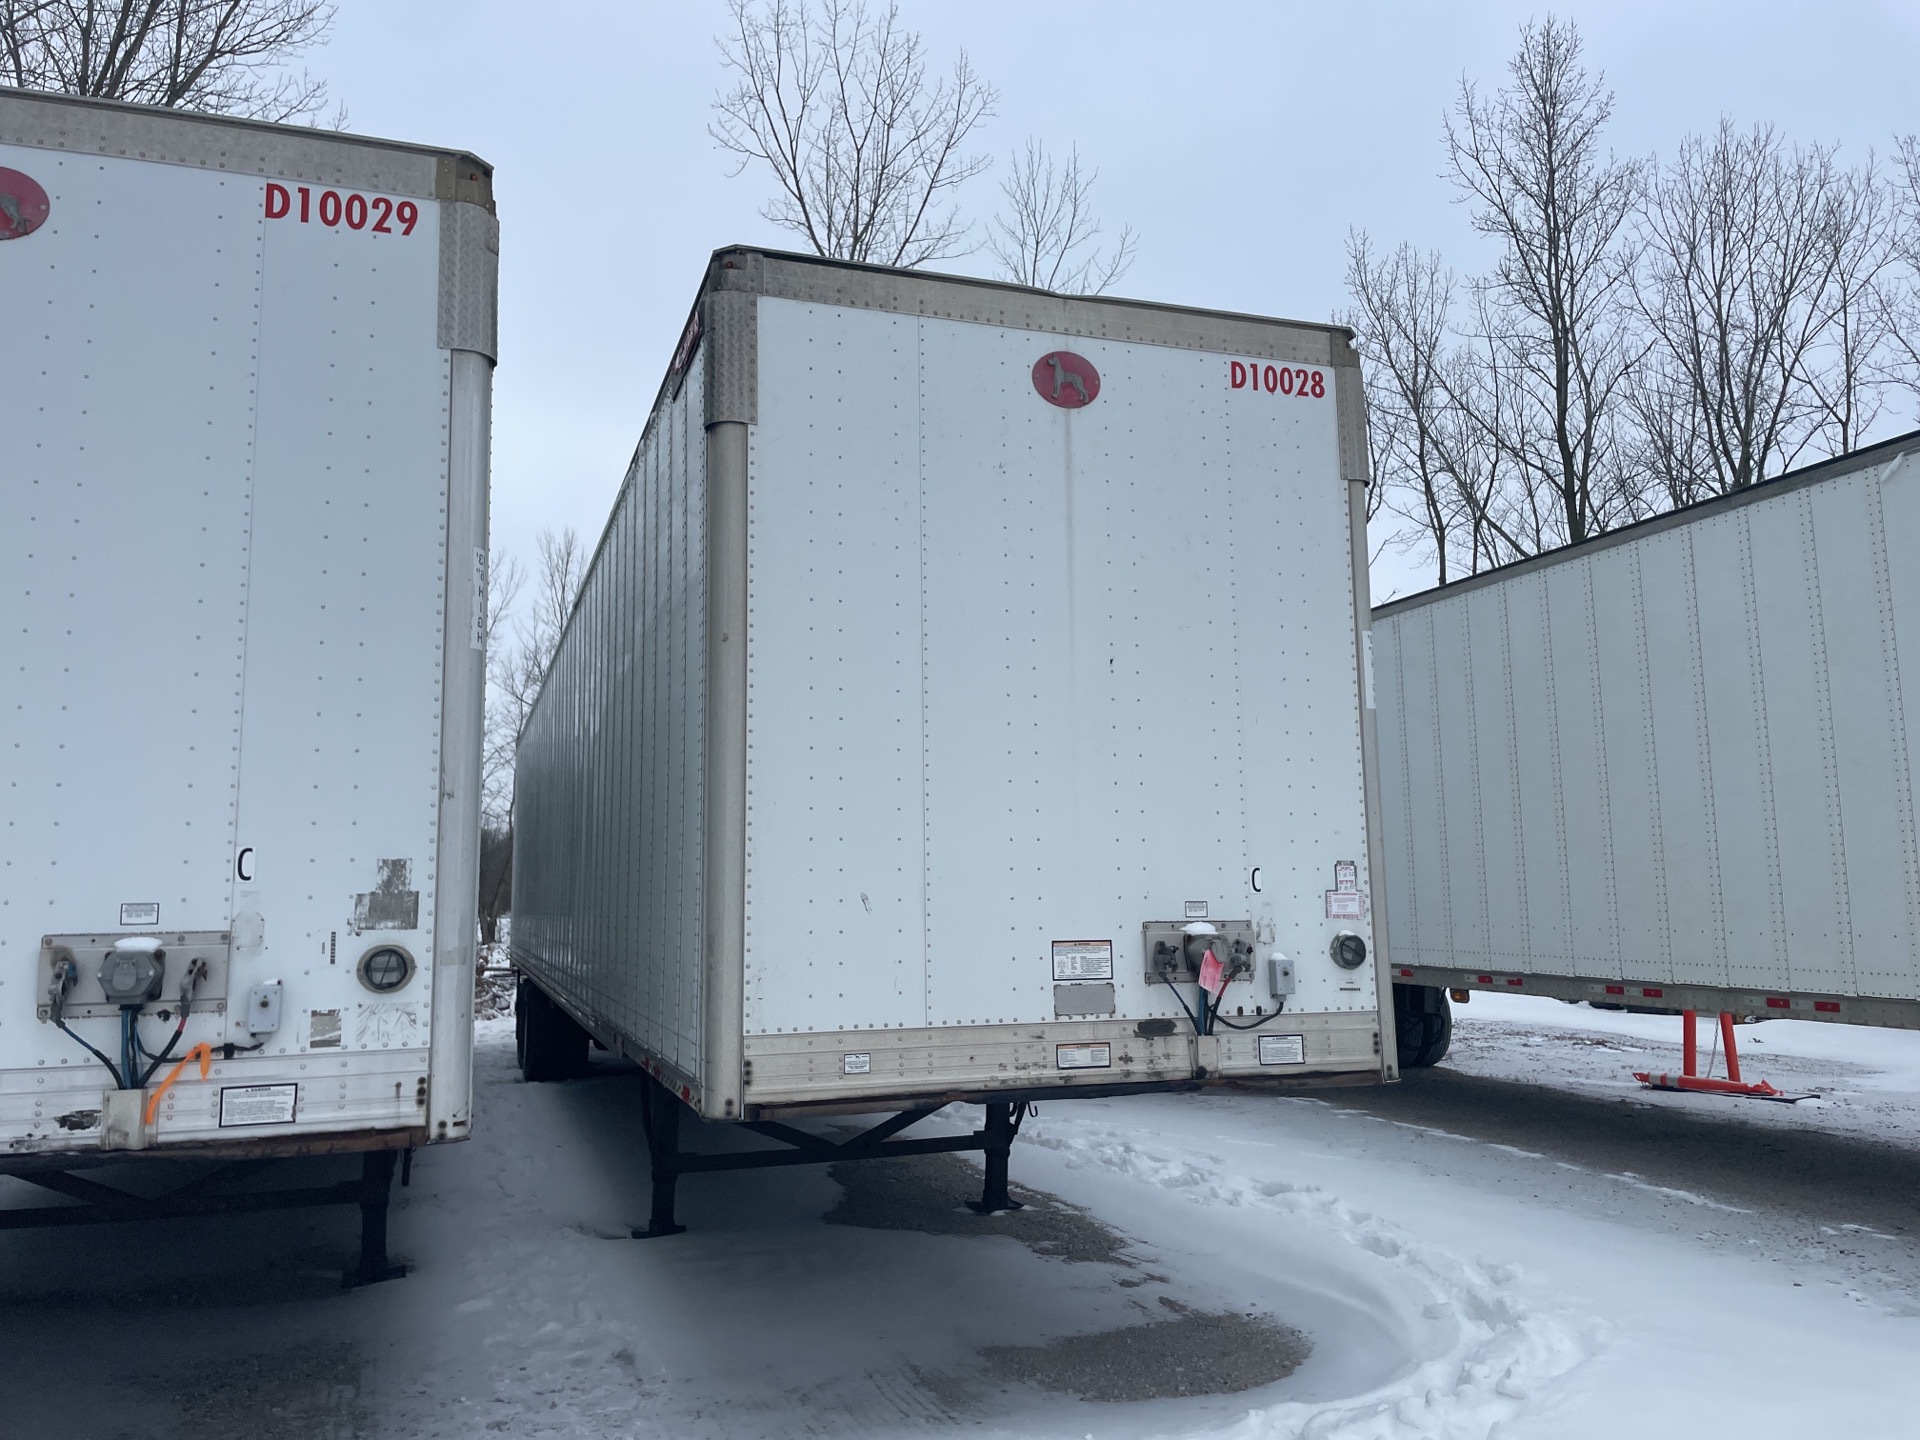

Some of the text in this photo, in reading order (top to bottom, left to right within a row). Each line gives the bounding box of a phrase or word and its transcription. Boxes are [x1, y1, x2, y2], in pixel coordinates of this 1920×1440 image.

[265, 182, 419, 236] D10029
[1230, 360, 1326, 399] D10028
[237, 847, 253, 881] C
[1252, 867, 1262, 892] C
